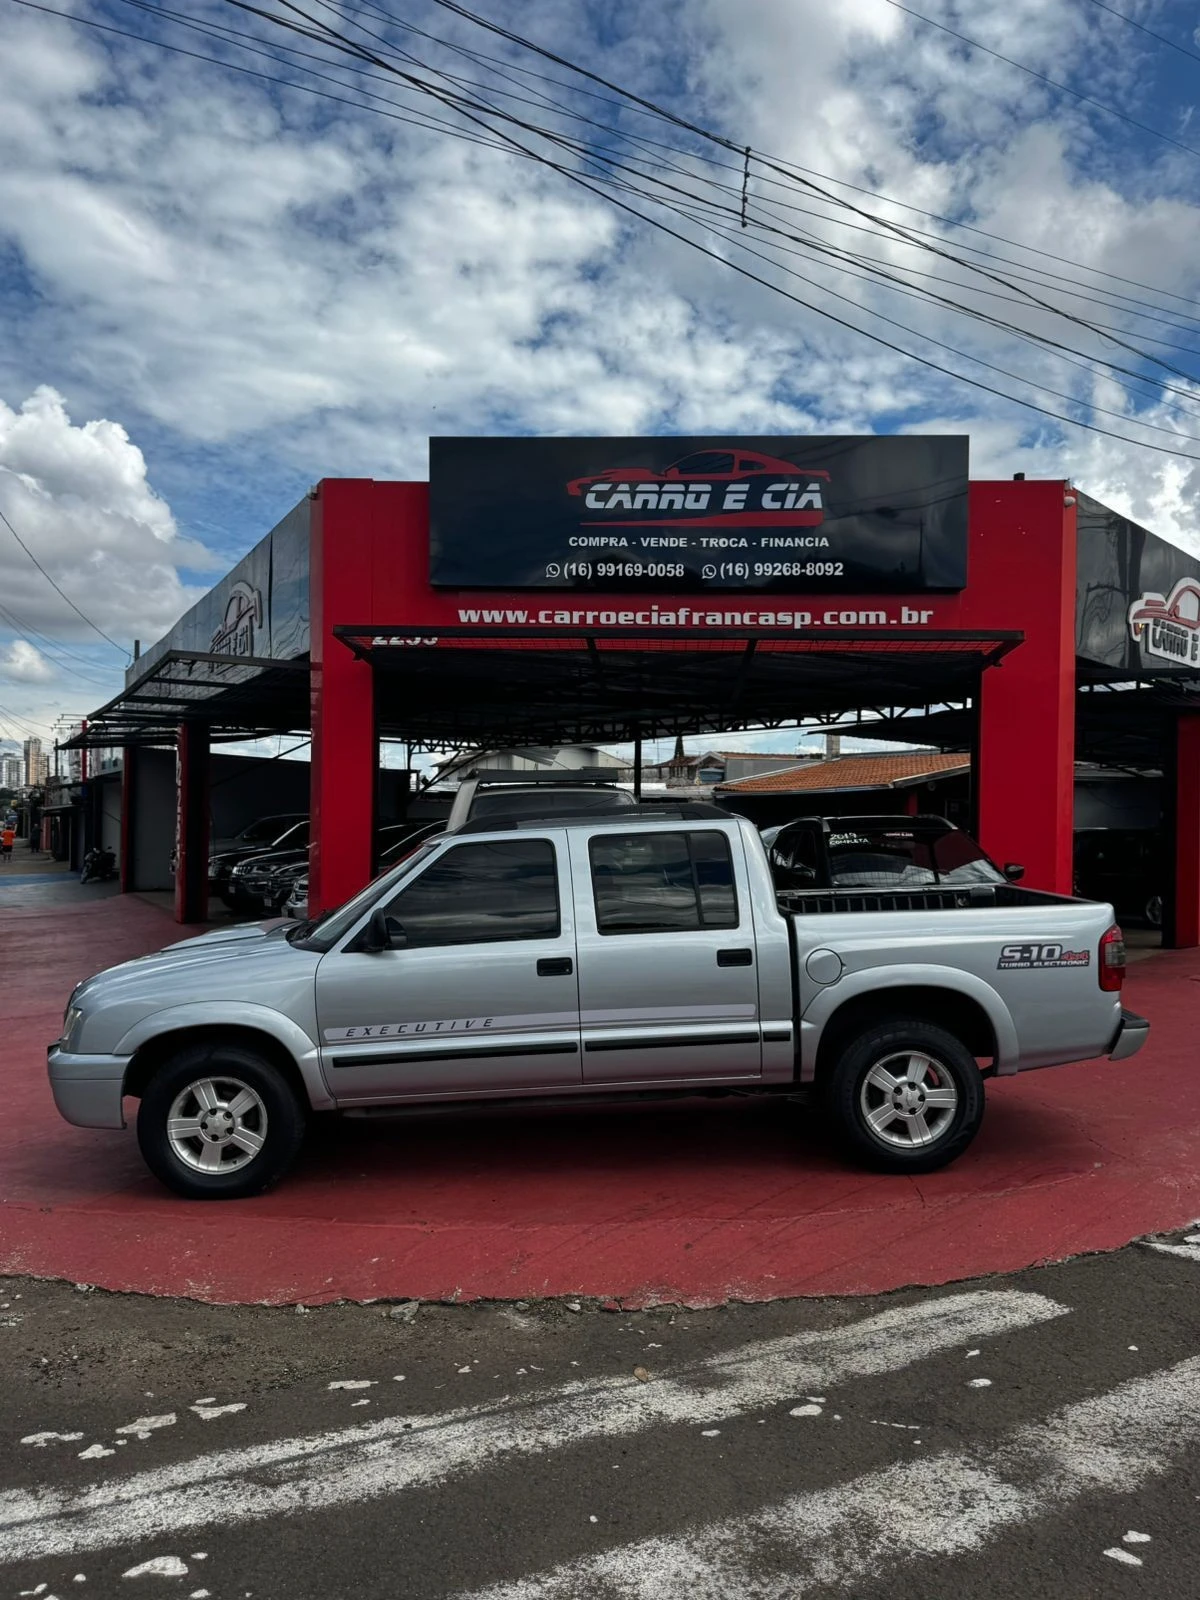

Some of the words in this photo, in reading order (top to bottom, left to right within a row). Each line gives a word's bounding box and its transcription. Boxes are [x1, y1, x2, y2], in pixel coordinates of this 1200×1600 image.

[585, 483, 712, 510] CARRO
[722, 483, 751, 510] E
[761, 483, 823, 509] CIA
[568, 537, 628, 547] COMPRA
[640, 537, 688, 548] VENDE
[700, 538, 748, 548] TROCA
[760, 537, 829, 548] FINANCIA
[563, 562, 593, 579] (16)
[597, 563, 685, 577] 99169-0058
[720, 562, 749, 579] (16)
[753, 562, 844, 577] 99268-8092
[457, 605, 934, 629] www.carroeciafrancasp.com.br
[1002, 945, 1061, 961] S-10
[345, 1018, 494, 1037] EXECUTIVE
